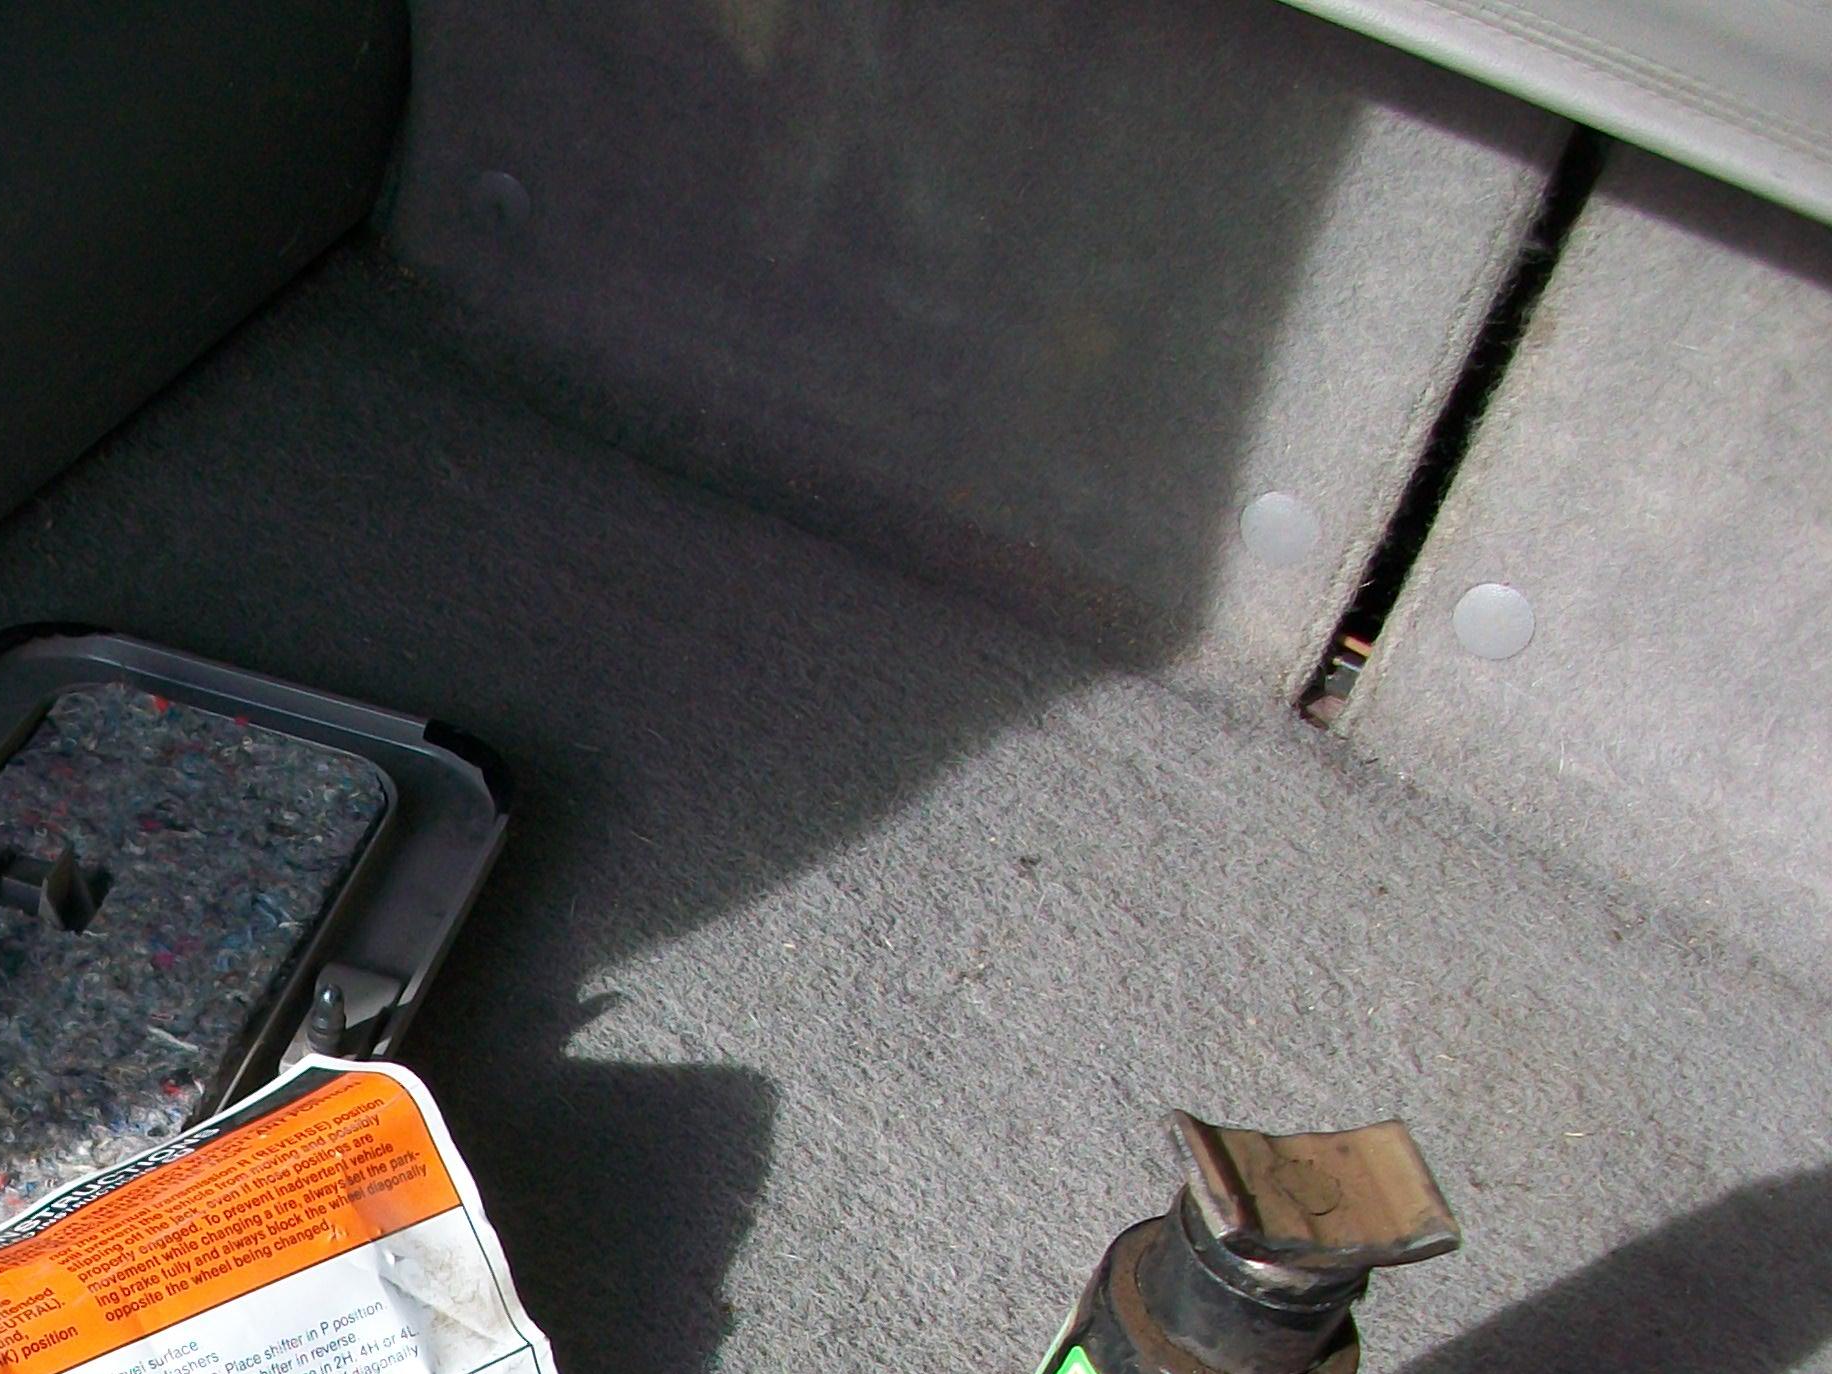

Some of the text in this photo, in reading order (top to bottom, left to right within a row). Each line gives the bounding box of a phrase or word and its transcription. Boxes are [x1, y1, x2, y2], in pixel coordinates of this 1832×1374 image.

[85, 1254, 162, 1293] movement
[159, 1240, 199, 1262] while
[199, 1213, 263, 1246] changing
[262, 1208, 274, 1220] a
[301, 1178, 346, 1204] always
[342, 1168, 366, 1187] set
[365, 1161, 388, 1178] the
[104, 1290, 164, 1322] opposite
[164, 1279, 190, 1296] the
[189, 1258, 232, 1285] wheel
[231, 1244, 273, 1268] being
[19, 1322, 78, 1360] position
[262, 1334, 303, 1361] shifter
[304, 1328, 319, 1343] in
[318, 1320, 329, 1336] P
